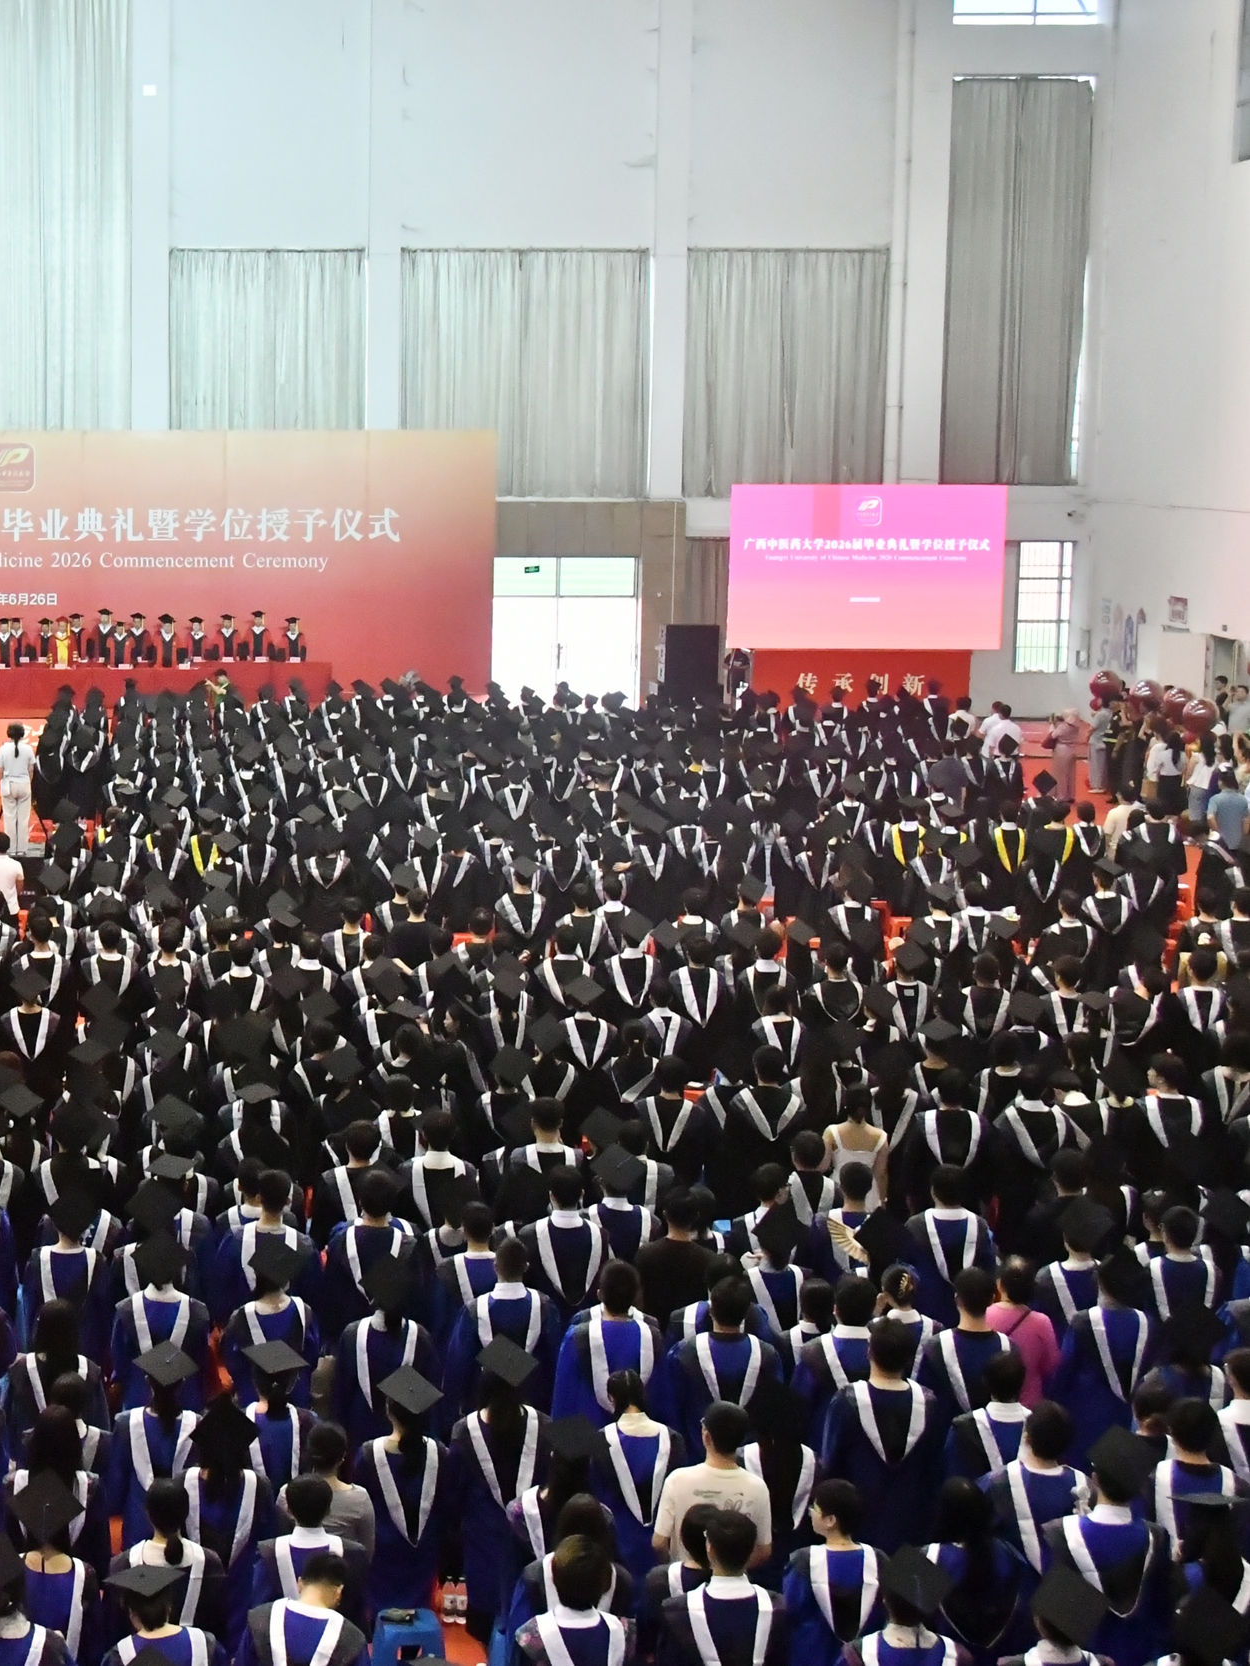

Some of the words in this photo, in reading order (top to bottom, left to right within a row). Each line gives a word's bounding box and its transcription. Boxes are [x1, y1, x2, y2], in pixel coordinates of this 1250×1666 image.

[51, 552, 92, 568] 2026
[99, 552, 235, 568] Commencement
[242, 552, 329, 573] Ceremony
